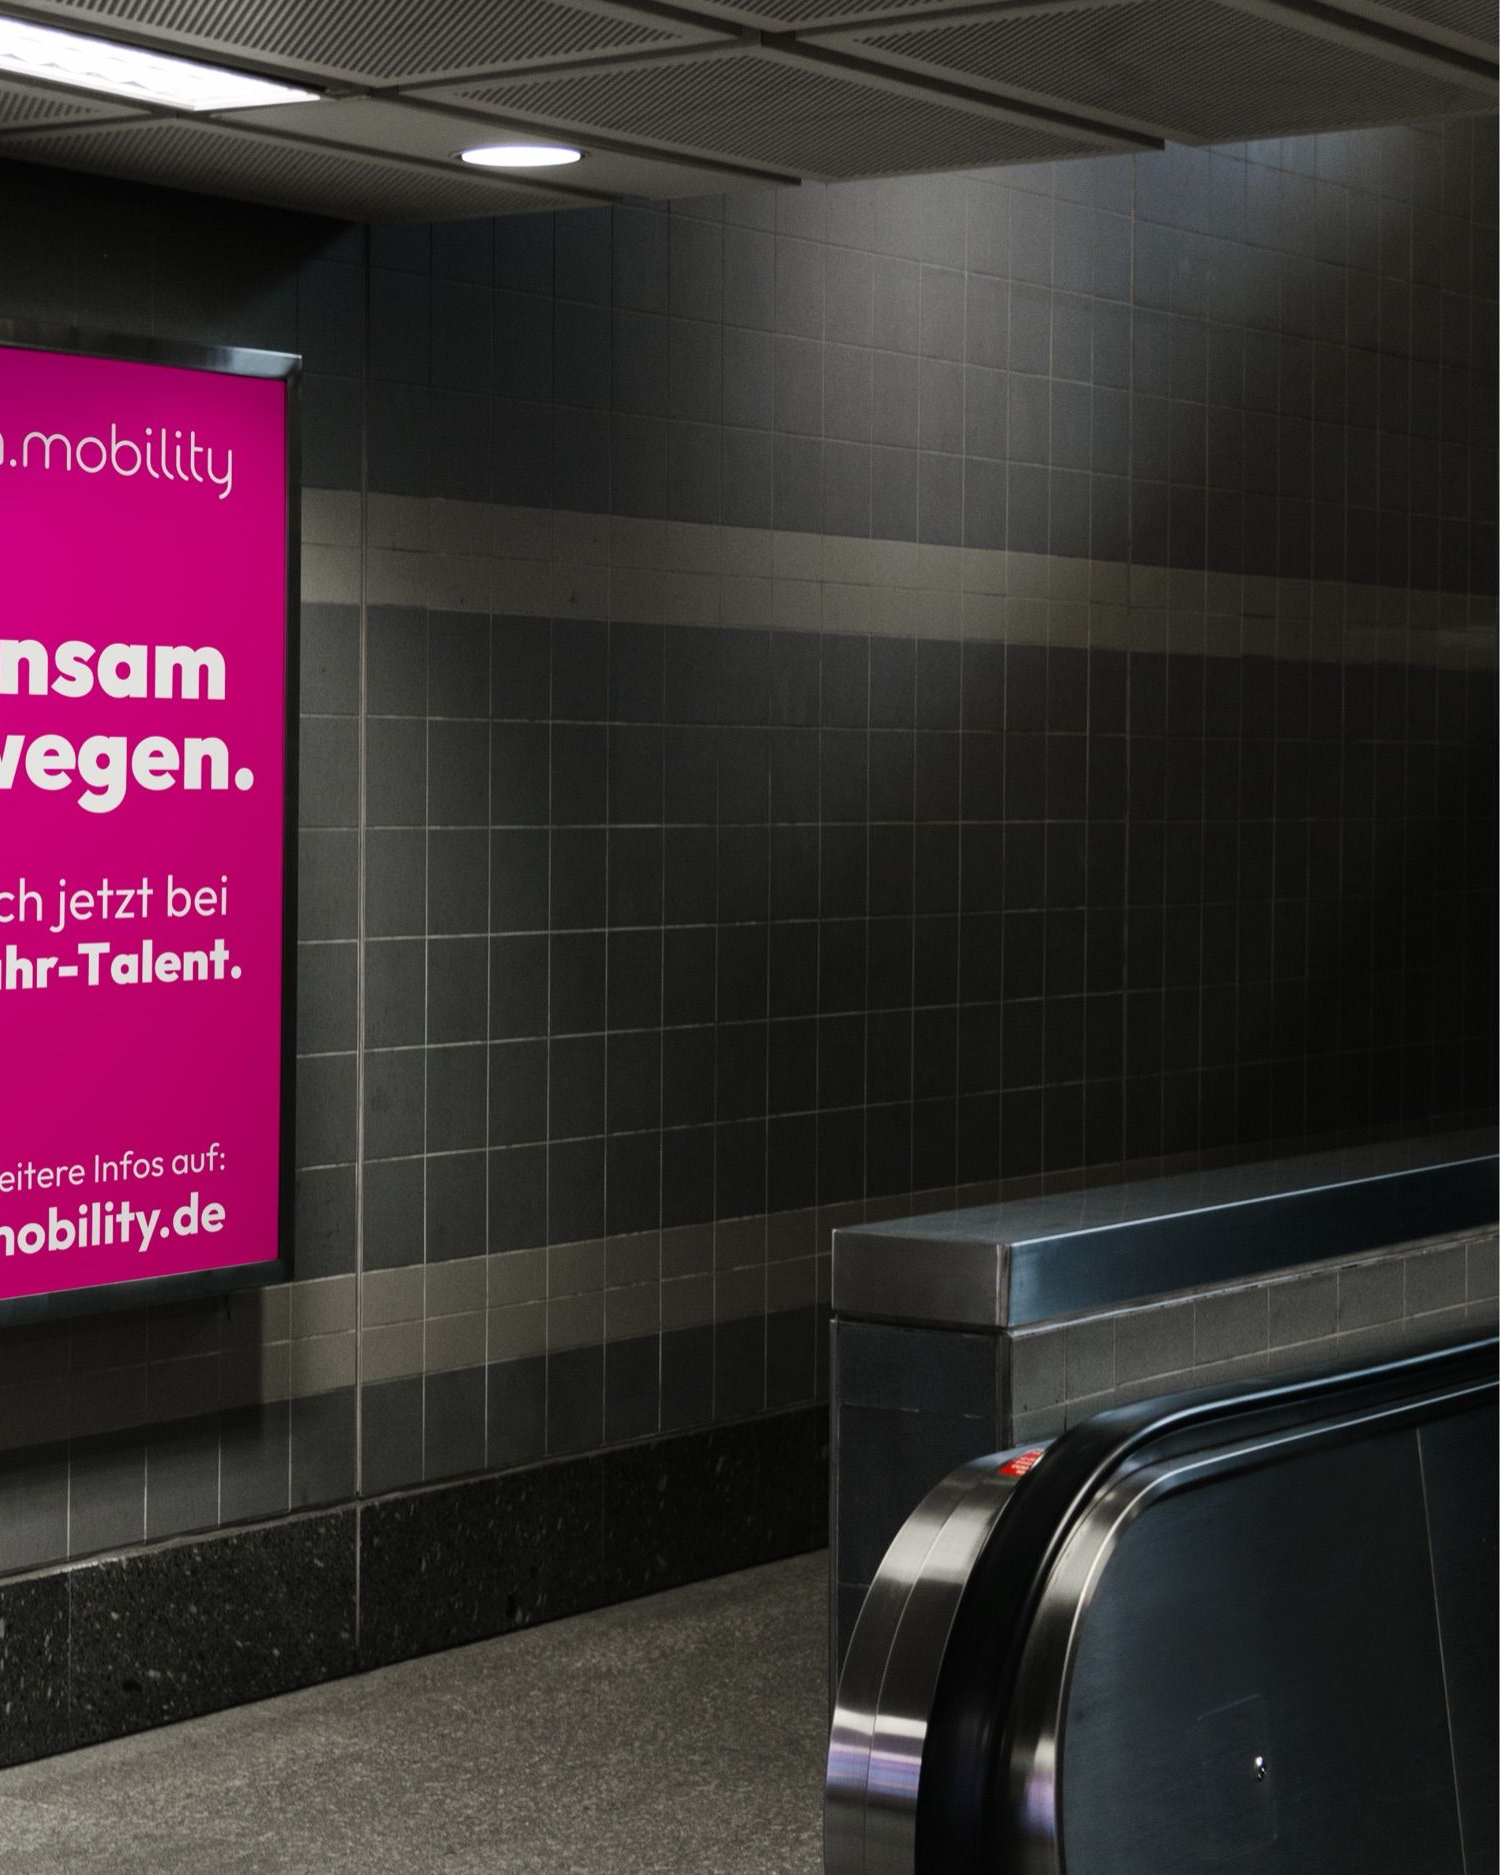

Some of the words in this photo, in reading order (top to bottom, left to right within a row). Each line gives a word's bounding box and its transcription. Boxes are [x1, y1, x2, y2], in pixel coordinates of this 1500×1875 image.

[49, 878, 154, 932] jetzt
[167, 875, 228, 917] bei
[95, 1151, 164, 1183] Infos
[172, 1143, 226, 1175] auf:
